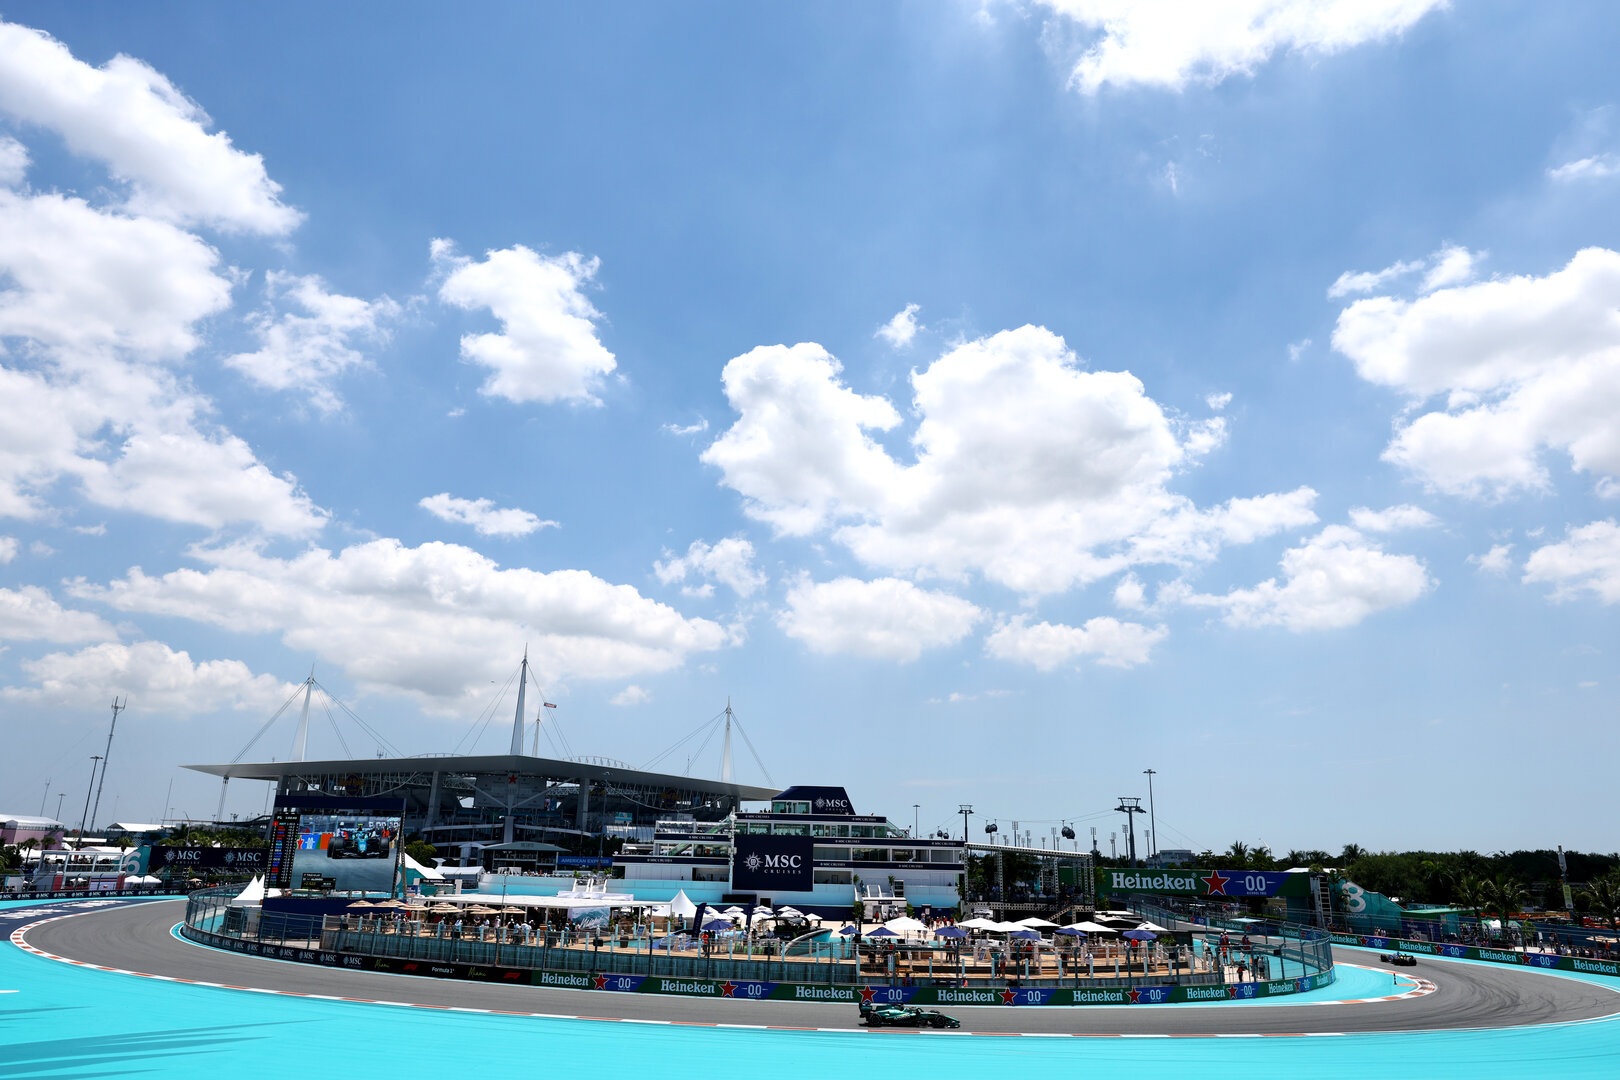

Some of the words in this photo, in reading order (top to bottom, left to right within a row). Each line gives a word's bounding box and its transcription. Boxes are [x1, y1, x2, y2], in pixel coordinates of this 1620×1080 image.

[826, 799, 848, 808] MSC
[177, 850, 201, 860] MSC
[237, 852, 261, 862] MSC
[124, 851, 141, 875] 6
[764, 854, 802, 868] MSC
[1112, 872, 1196, 890] Heineken
[1246, 876, 1266, 891] 0.0
[1341, 882, 1366, 912] 8
[1400, 941, 1432, 952] Heineken
[284, 949, 294, 957] MSC
[304, 952, 315, 960] MSC
[325, 954, 337, 962] MSC
[1479, 950, 1517, 962] Heineken
[349, 957, 363, 965] MSC
[1573, 960, 1617, 973] Heineken
[541, 972, 589, 986] Heineken
[618, 977, 630, 989] 0.0
[661, 980, 715, 993] Heineken
[748, 984, 761, 995] 0.0
[1269, 983, 1293, 993] Heineken
[796, 986, 853, 999] Heineken
[888, 989, 902, 1000] 0.0
[938, 990, 995, 1002] Heineken
[1028, 990, 1041, 1002] 0.0
[1073, 991, 1123, 1002] Heineken
[1150, 990, 1161, 1000] 0.0
[1187, 988, 1225, 999] Heineken
